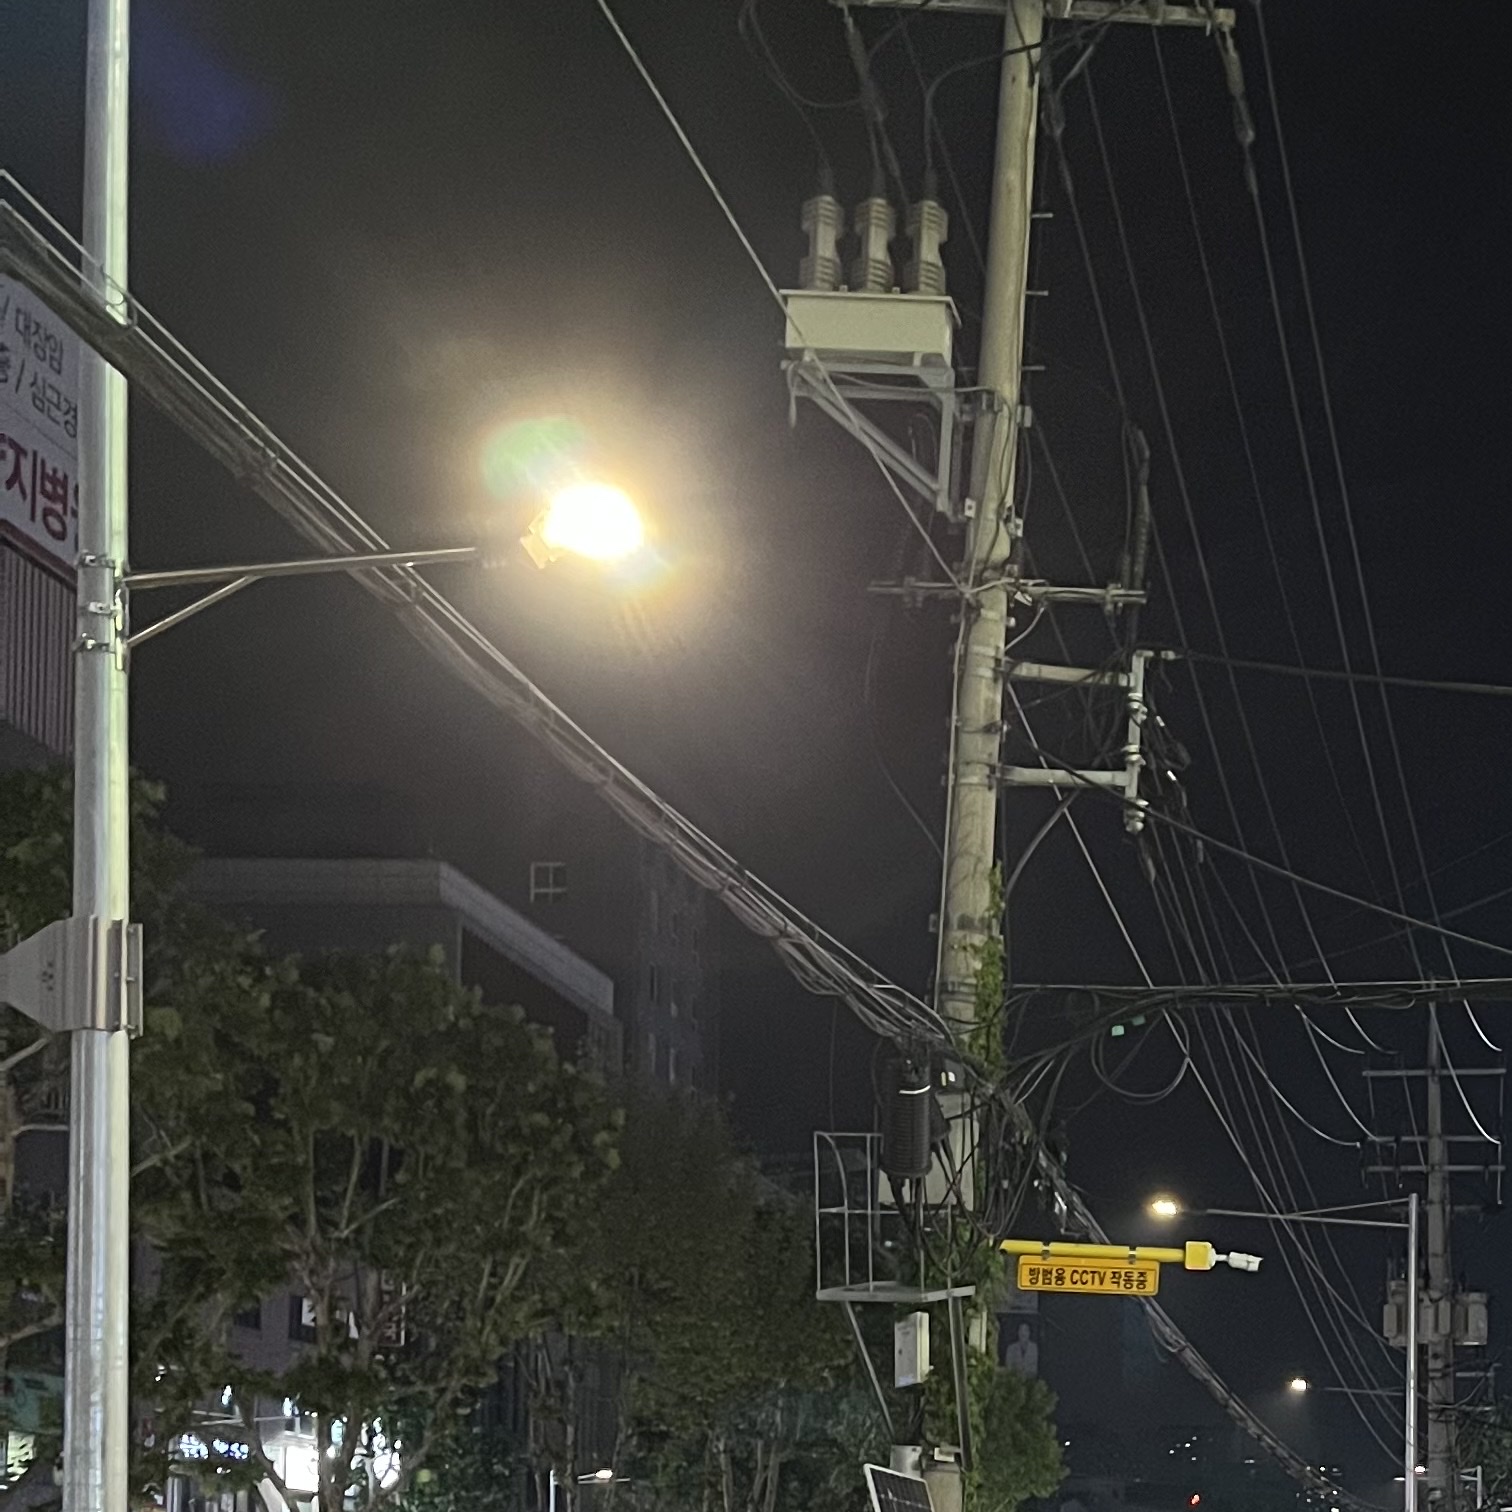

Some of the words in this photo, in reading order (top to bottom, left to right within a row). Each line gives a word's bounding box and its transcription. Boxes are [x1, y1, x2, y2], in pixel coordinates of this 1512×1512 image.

[1028, 1266, 1066, 1286] 방범용
[1069, 1269, 1107, 1286] CCTV
[1110, 1270, 1148, 1290] 작동중
